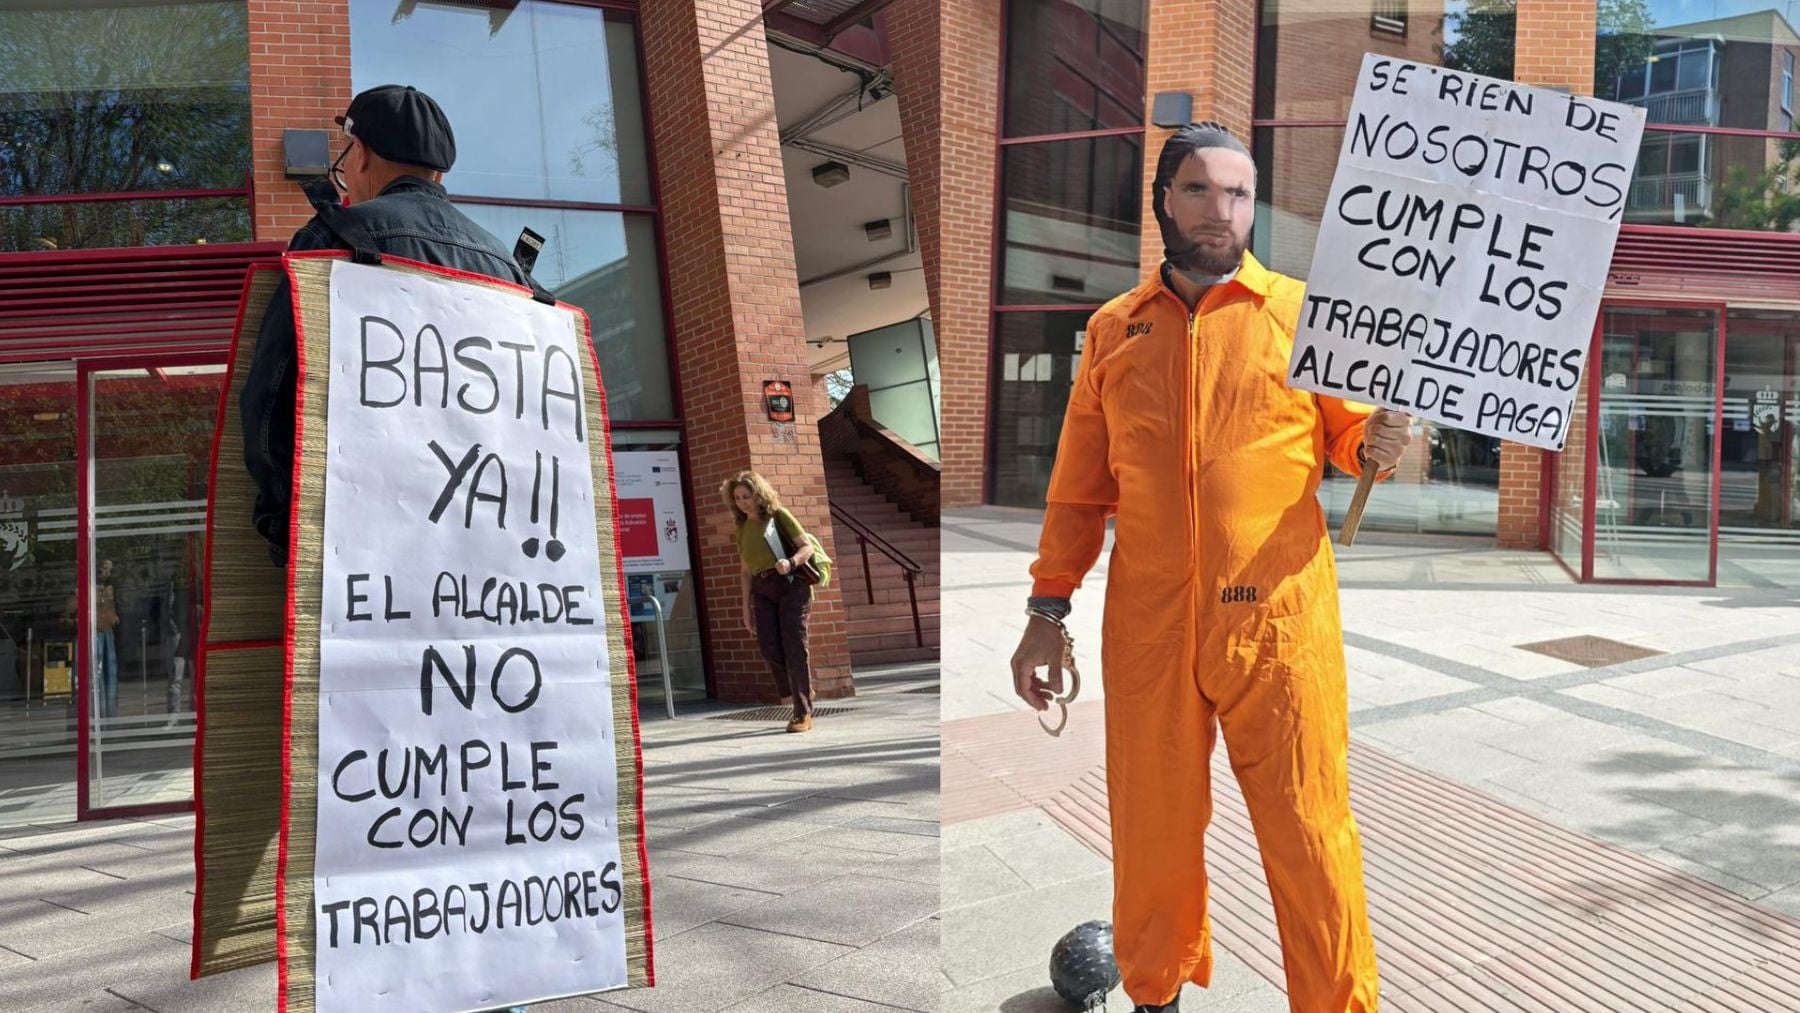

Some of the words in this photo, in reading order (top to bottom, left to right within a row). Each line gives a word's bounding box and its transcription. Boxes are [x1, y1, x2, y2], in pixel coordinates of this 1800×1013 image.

[1369, 60, 1416, 95] SE
[1565, 96, 1620, 143] DE
[1338, 184, 1554, 270] CUMPLE
[1357, 237, 1456, 287] CON
[1479, 263, 1568, 320] LOS
[360, 315, 584, 442] BASTA
[1292, 344, 1464, 421] ALCALDE
[1307, 294, 1582, 391] TRABAJADORES
[346, 573, 411, 623] EL
[432, 571, 594, 625] ALCALDE
[1221, 586, 1257, 603] 888
[420, 644, 542, 715] NO
[332, 739, 560, 802] CUMPLE
[367, 804, 474, 849] CON
[505, 793, 585, 845] LOS
[321, 861, 622, 948] TRABAJADORES
